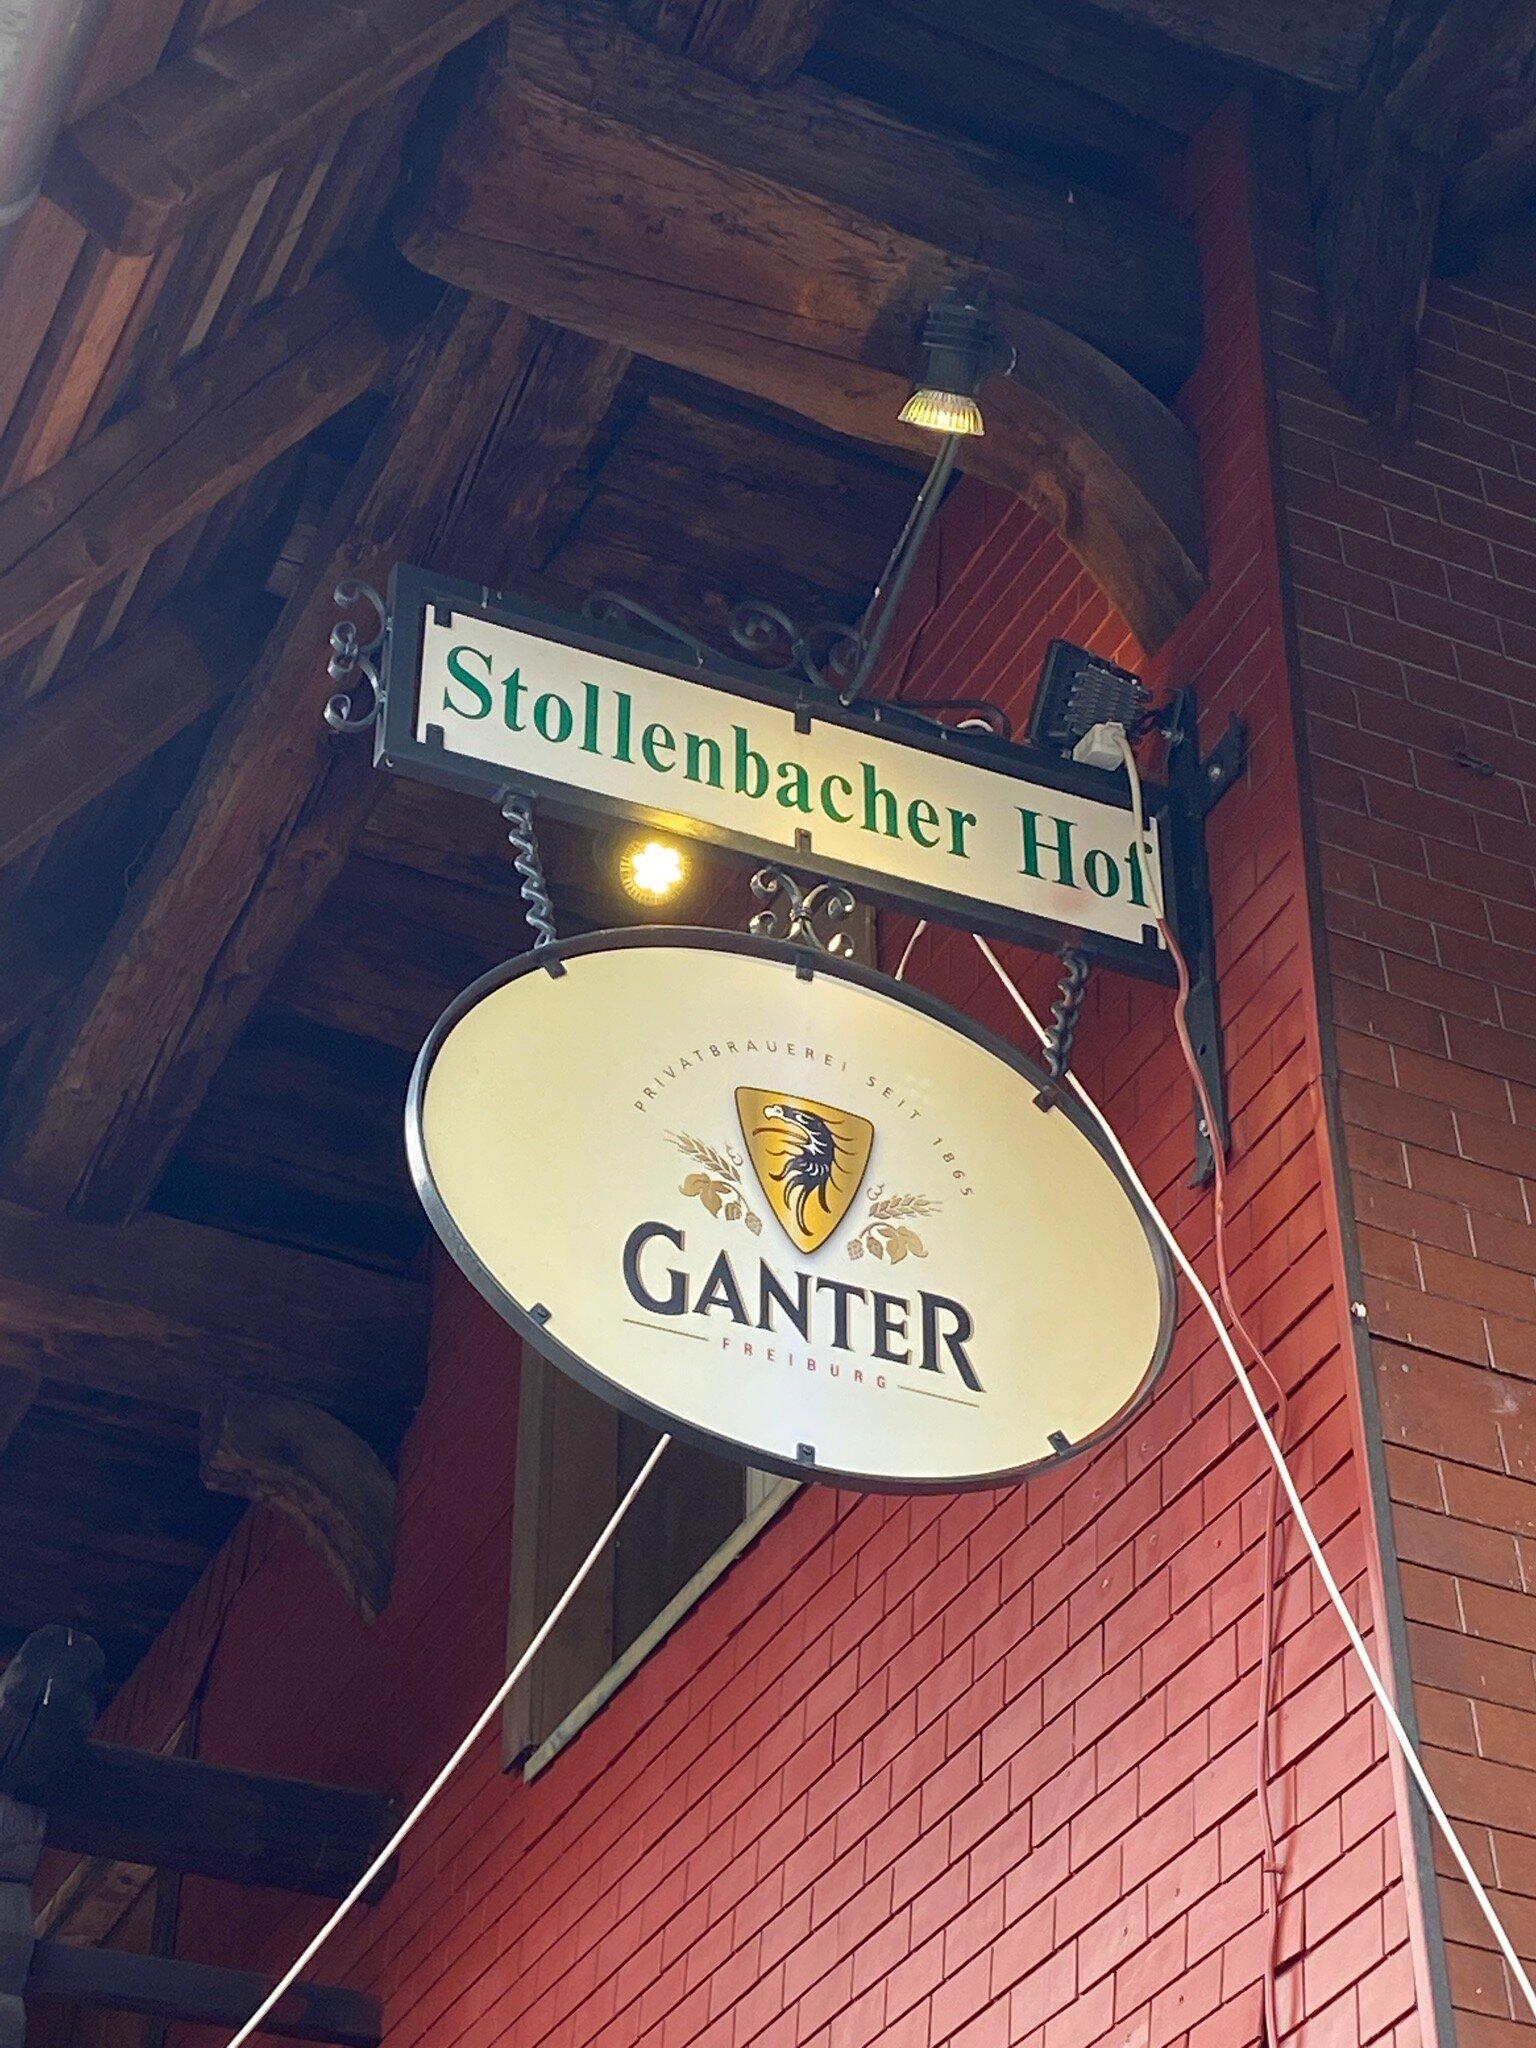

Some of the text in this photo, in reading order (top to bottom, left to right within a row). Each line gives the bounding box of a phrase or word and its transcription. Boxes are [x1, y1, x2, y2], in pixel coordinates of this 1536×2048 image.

[443, 645, 1153, 908] Stollenbacher Hof
[634, 1039, 974, 1197] PRIVATBRAUEREI SEIT 1865
[623, 1221, 987, 1393] GANTER
[722, 1337, 887, 1389] FREIBURG
